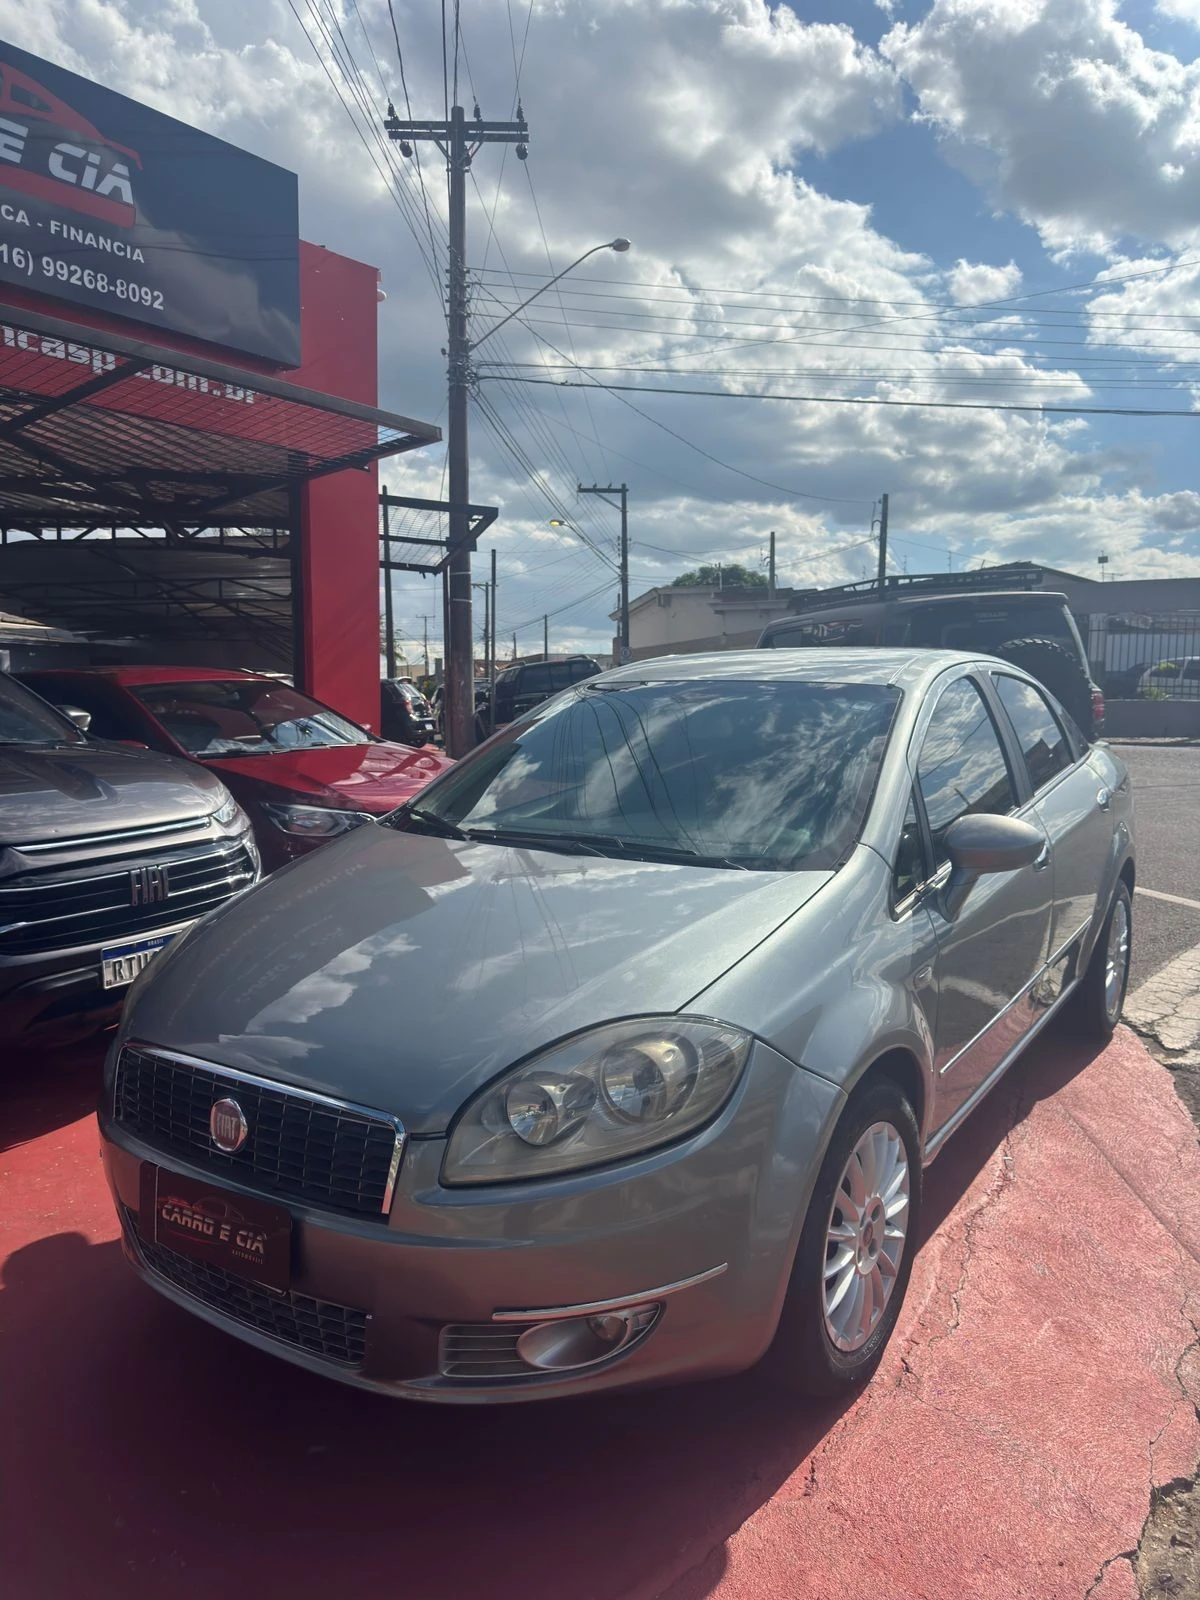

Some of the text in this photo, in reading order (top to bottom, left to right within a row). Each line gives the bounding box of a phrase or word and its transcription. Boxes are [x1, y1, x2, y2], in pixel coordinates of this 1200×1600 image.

[50, 220, 145, 264] FINANCIA
[42, 256, 164, 311] 99268-8092
[130, 865, 169, 907] FIAT
[217, 1112, 239, 1140] FIAT
[219, 1224, 231, 1241] E
